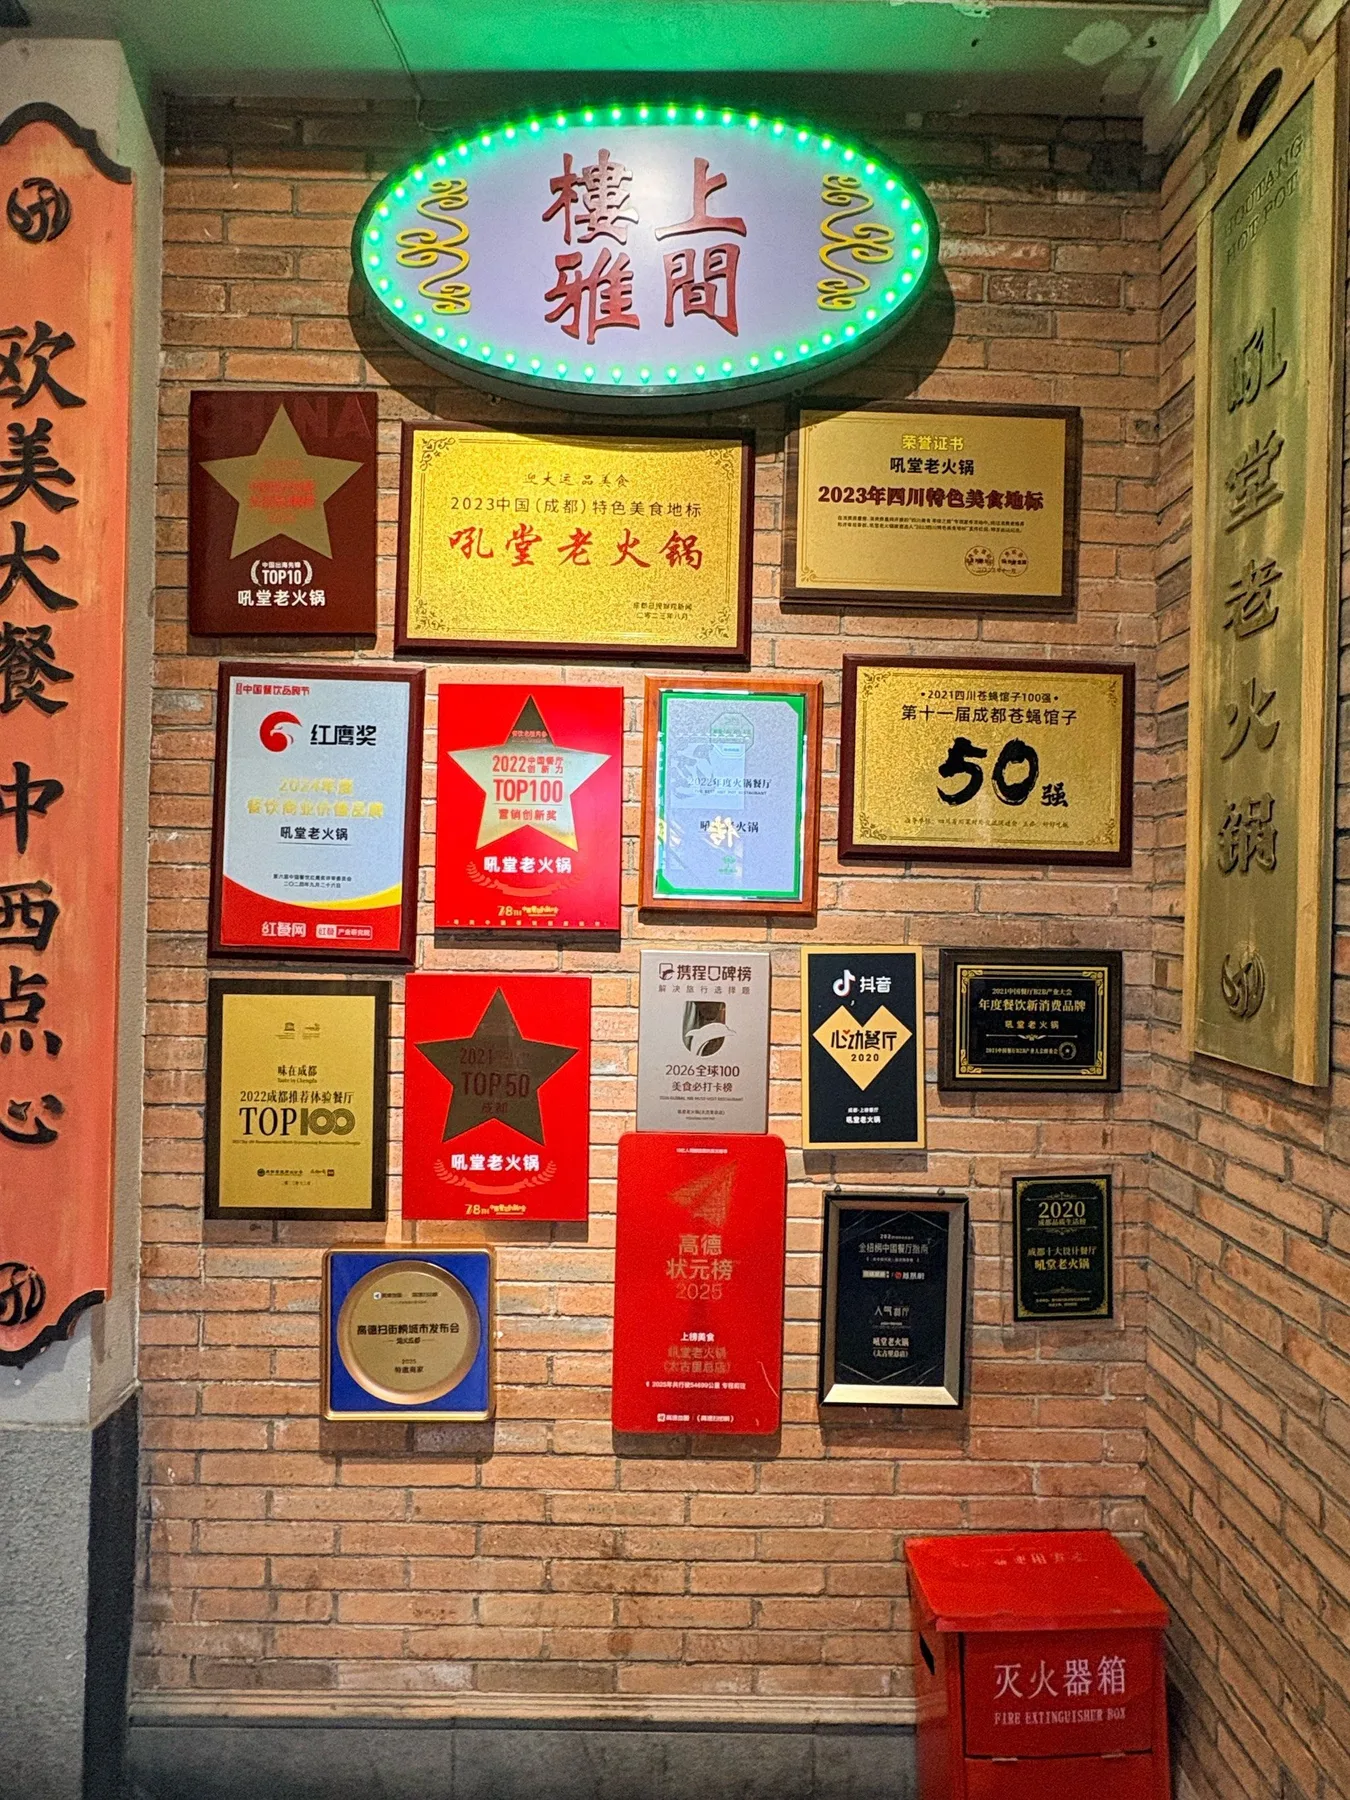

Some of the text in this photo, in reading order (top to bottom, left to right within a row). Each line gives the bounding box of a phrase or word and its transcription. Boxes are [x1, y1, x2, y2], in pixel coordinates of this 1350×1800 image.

[542, 148, 747, 246] 樓上
[543, 242, 739, 344] 雅間
[902, 435, 964, 451] 荣誉证书
[890, 457, 975, 476] 吼堂老火锅
[818, 484, 1044, 511] 2023年四川特色美食地标
[262, 569, 301, 585] TOP10
[238, 590, 326, 607] 吼堂老火锅
[901, 704, 1077, 726] 第十一届成都苍蝇馆子
[310, 723, 377, 746] 红鹰奖
[492, 755, 526, 774] 2022
[279, 777, 354, 795] 2024年度
[493, 779, 563, 803] TOP100
[499, 809, 557, 821] 营销创新奖
[280, 826, 348, 841] 吼堂老火锅
[484, 856, 572, 874] 吼堂老火锅
[262, 921, 307, 938] 红餐网
[677, 965, 752, 981] 携程口碑榜
[859, 976, 892, 993] 抖音
[979, 998, 1086, 1012] 年度餐饮新消费品牌
[1004, 1020, 1060, 1030] 吼堂老火锅
[830, 1029, 897, 1052] 心动餐厅
[851, 1053, 880, 1062] 2020
[277, 1065, 317, 1077] 味在成都
[665, 1064, 740, 1077] 2026全球100
[672, 1081, 733, 1093] 美食必打卡榜
[240, 1090, 354, 1104] 2022成都推荐体验餐厅
[451, 1154, 540, 1171] 吼堂老火锅
[1038, 1201, 1086, 1219] 2020
[678, 1234, 722, 1255] 高德
[666, 1258, 733, 1281] 状元榜
[1034, 1259, 1090, 1271] 吼堂老火锅
[676, 1283, 723, 1300] 2025
[993, 1655, 1126, 1700] 灭火器箱
[994, 1711, 1021, 1725] FIRE
[1107, 1707, 1126, 1720] BOX
